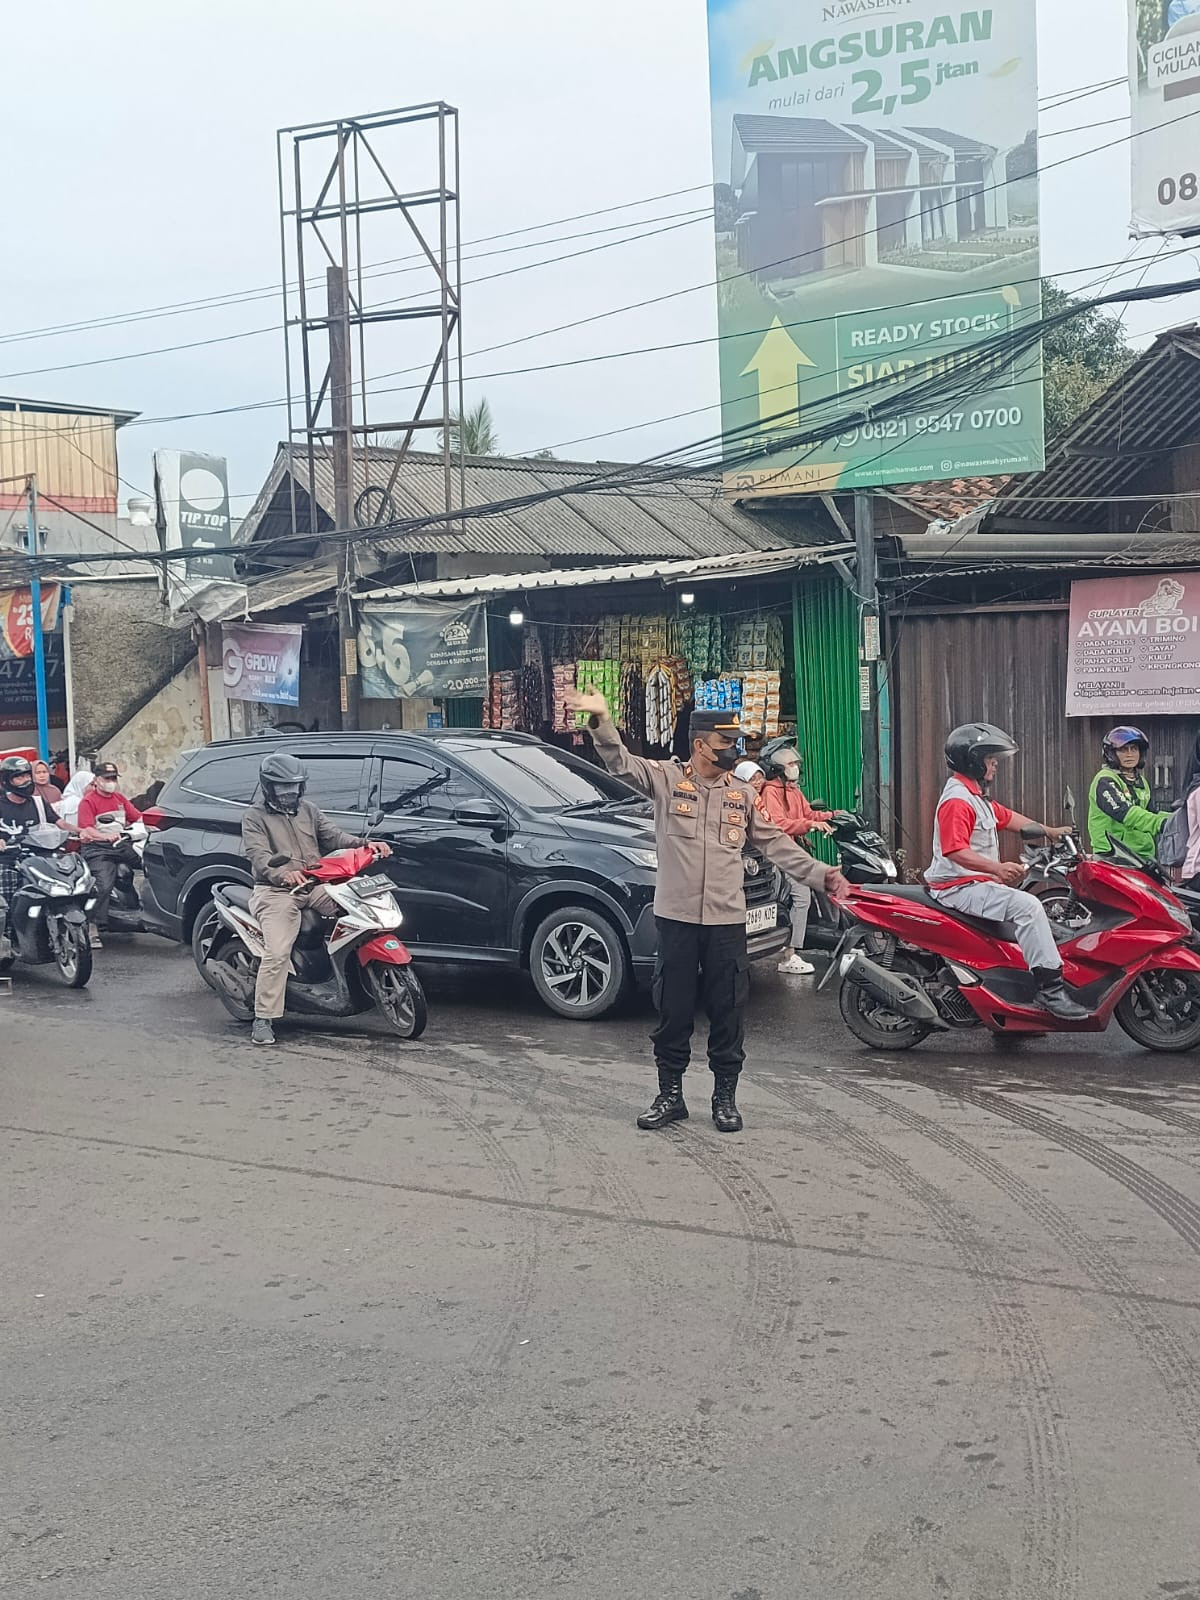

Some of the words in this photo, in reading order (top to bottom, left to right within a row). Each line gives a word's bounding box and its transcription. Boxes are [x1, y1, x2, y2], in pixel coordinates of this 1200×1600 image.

[748, 9, 993, 88] ANGSURAN
[769, 88, 811, 111] mulai
[814, 82, 846, 103] dari
[851, 59, 932, 115] 2,5
[935, 60, 980, 87] jtan
[1157, 172, 1199, 206] 08
[851, 322, 924, 348] READY
[929, 313, 1001, 338] STOCK
[861, 418, 909, 440] 0821
[915, 412, 965, 435] 9547
[970, 406, 1023, 429] 0700
[180, 511, 202, 524] TIP
[203, 513, 228, 527] TOP
[1088, 608, 1140, 619] SUPLAYER
[1077, 618, 1147, 638] AYAM
[245, 652, 279, 673] GROW
[1078, 681, 1121, 689] MELAYANI
